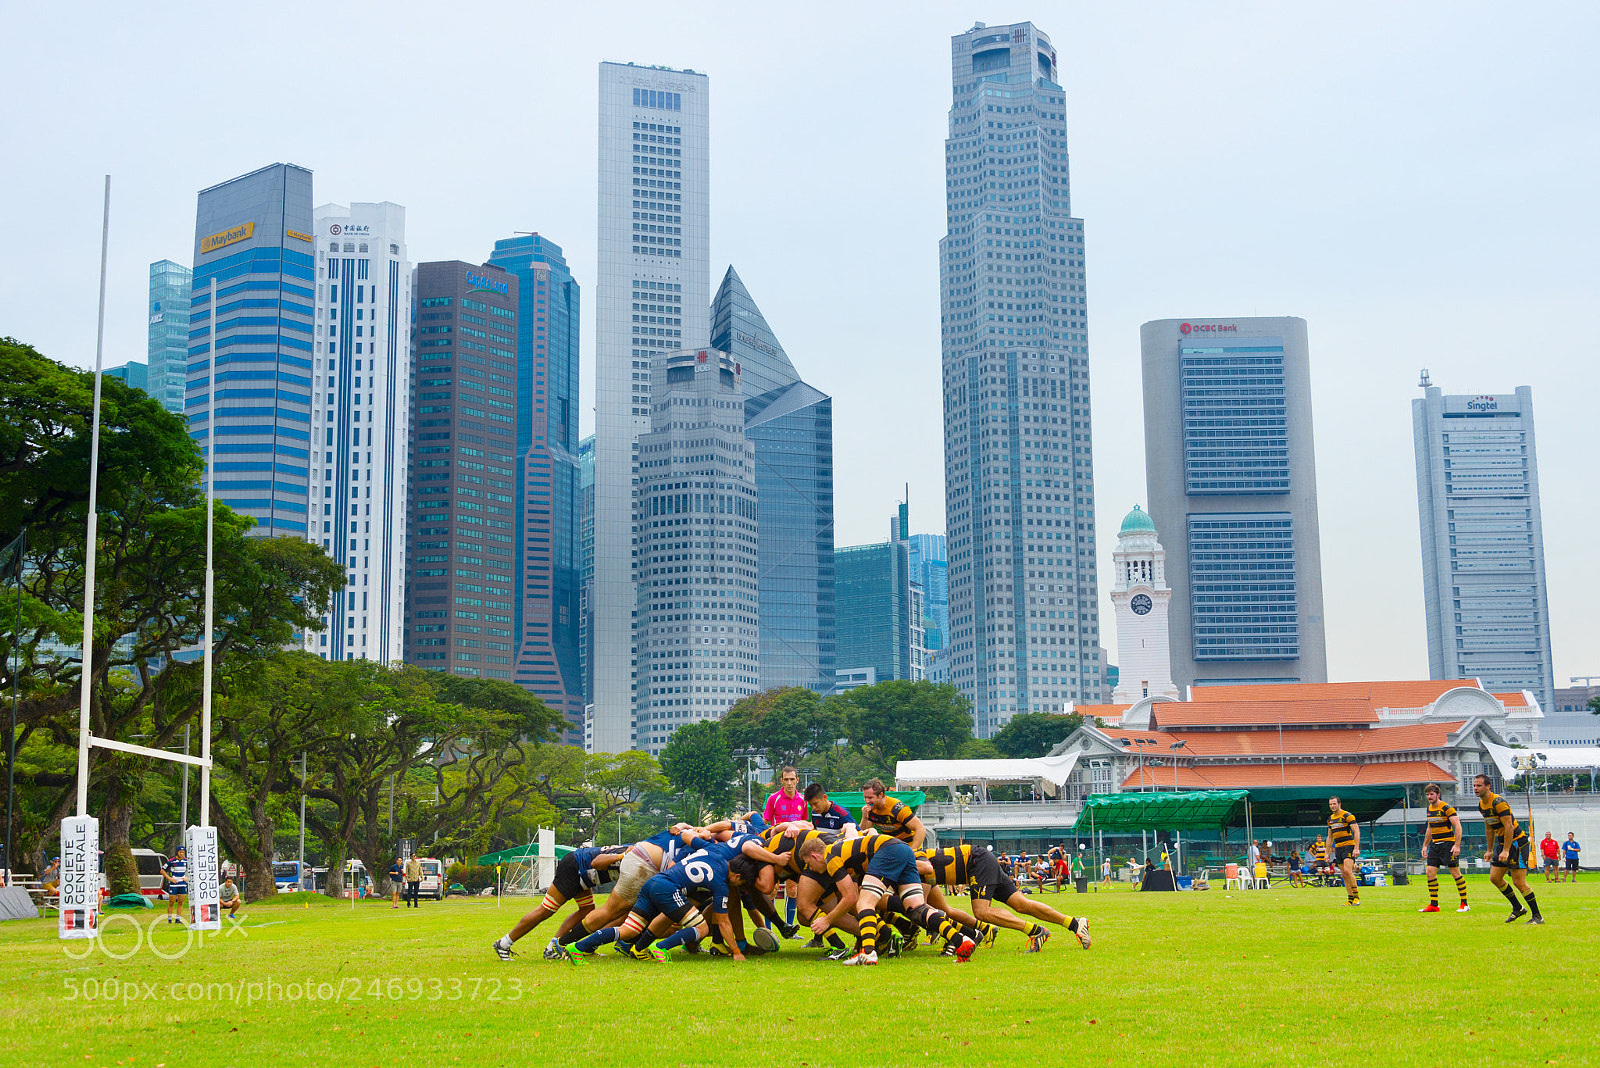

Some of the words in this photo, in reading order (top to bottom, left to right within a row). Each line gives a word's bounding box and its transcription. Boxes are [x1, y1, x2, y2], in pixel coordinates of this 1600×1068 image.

[211, 226, 247, 246] Maybank
[1193, 324, 1216, 332] OCBC
[1218, 323, 1238, 332] Bank
[694, 364, 711, 373] UOB
[1467, 400, 1498, 412] Singtel
[64, 839, 74, 905] SOCIETE
[75, 823, 86, 905] GENERALE
[198, 843, 208, 900] SOCIETE
[206, 831, 218, 899] GENERALE
[680, 848, 714, 883] 16
